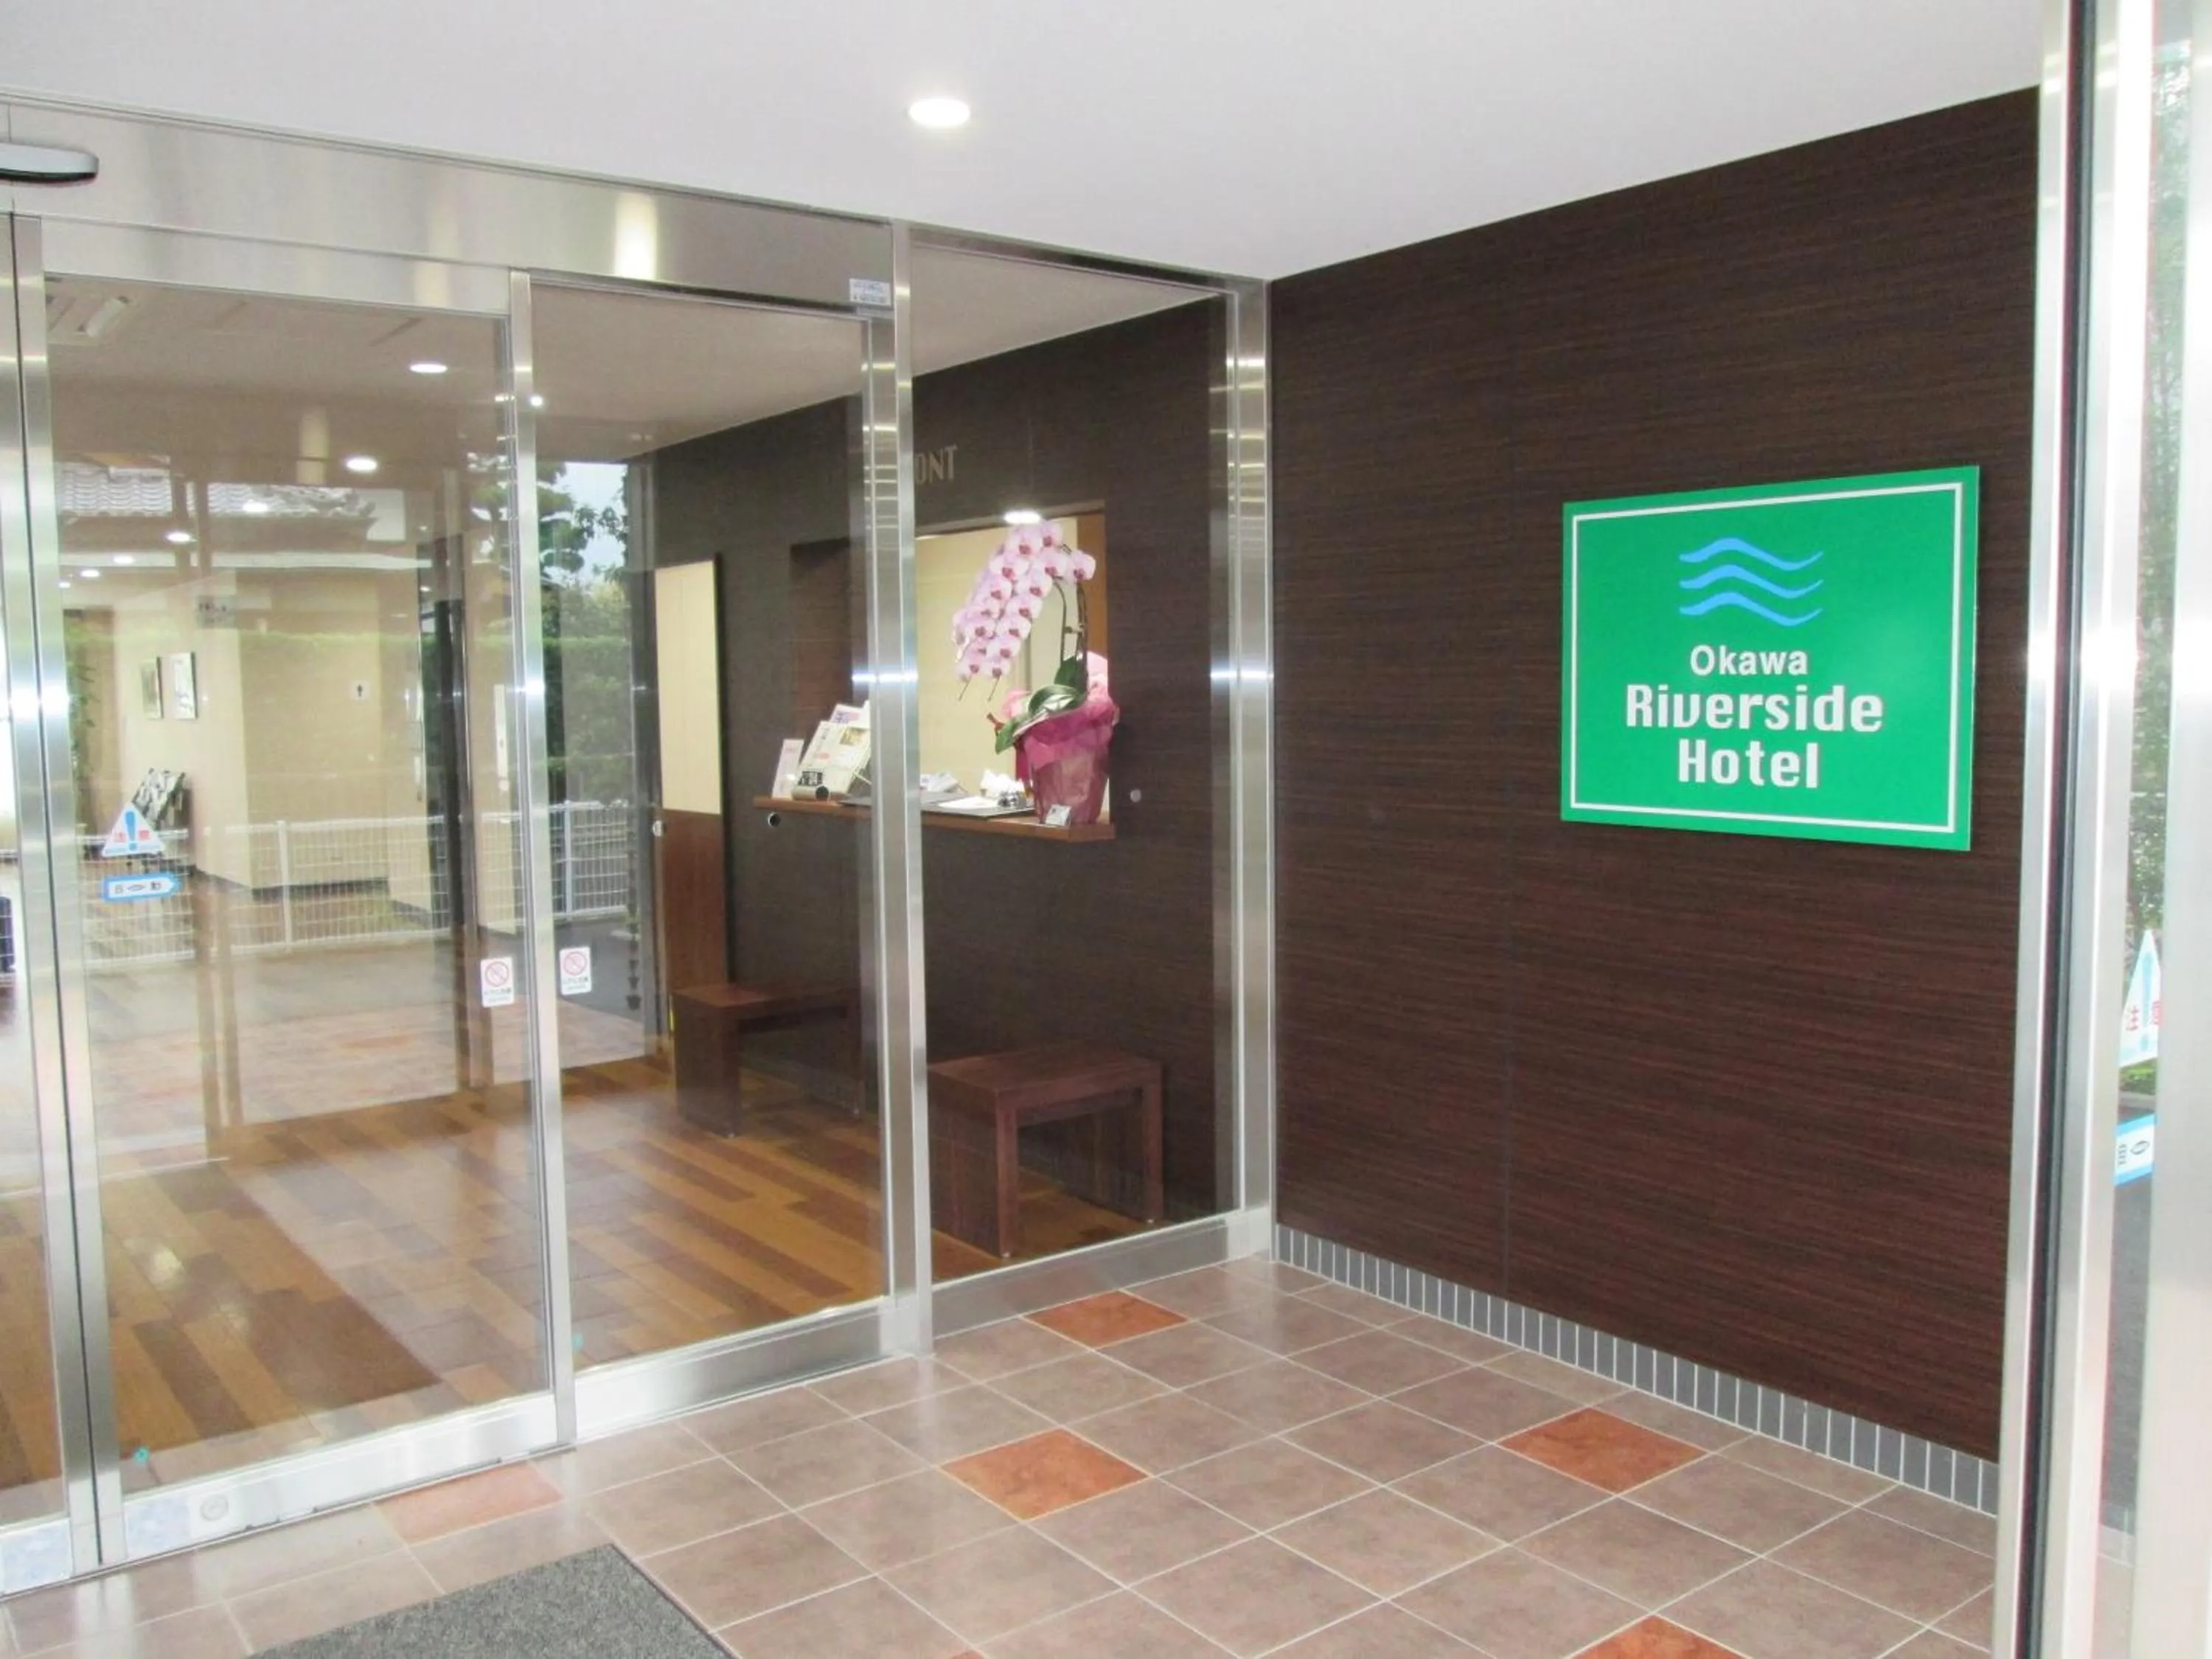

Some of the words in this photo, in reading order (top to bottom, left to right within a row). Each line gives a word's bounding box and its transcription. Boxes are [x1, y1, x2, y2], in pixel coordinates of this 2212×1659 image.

[914, 443, 958, 486] ONT
[1691, 645, 1807, 675] Okawa
[1627, 685, 1883, 731] Riverside
[1680, 739, 1818, 787] Hotel
